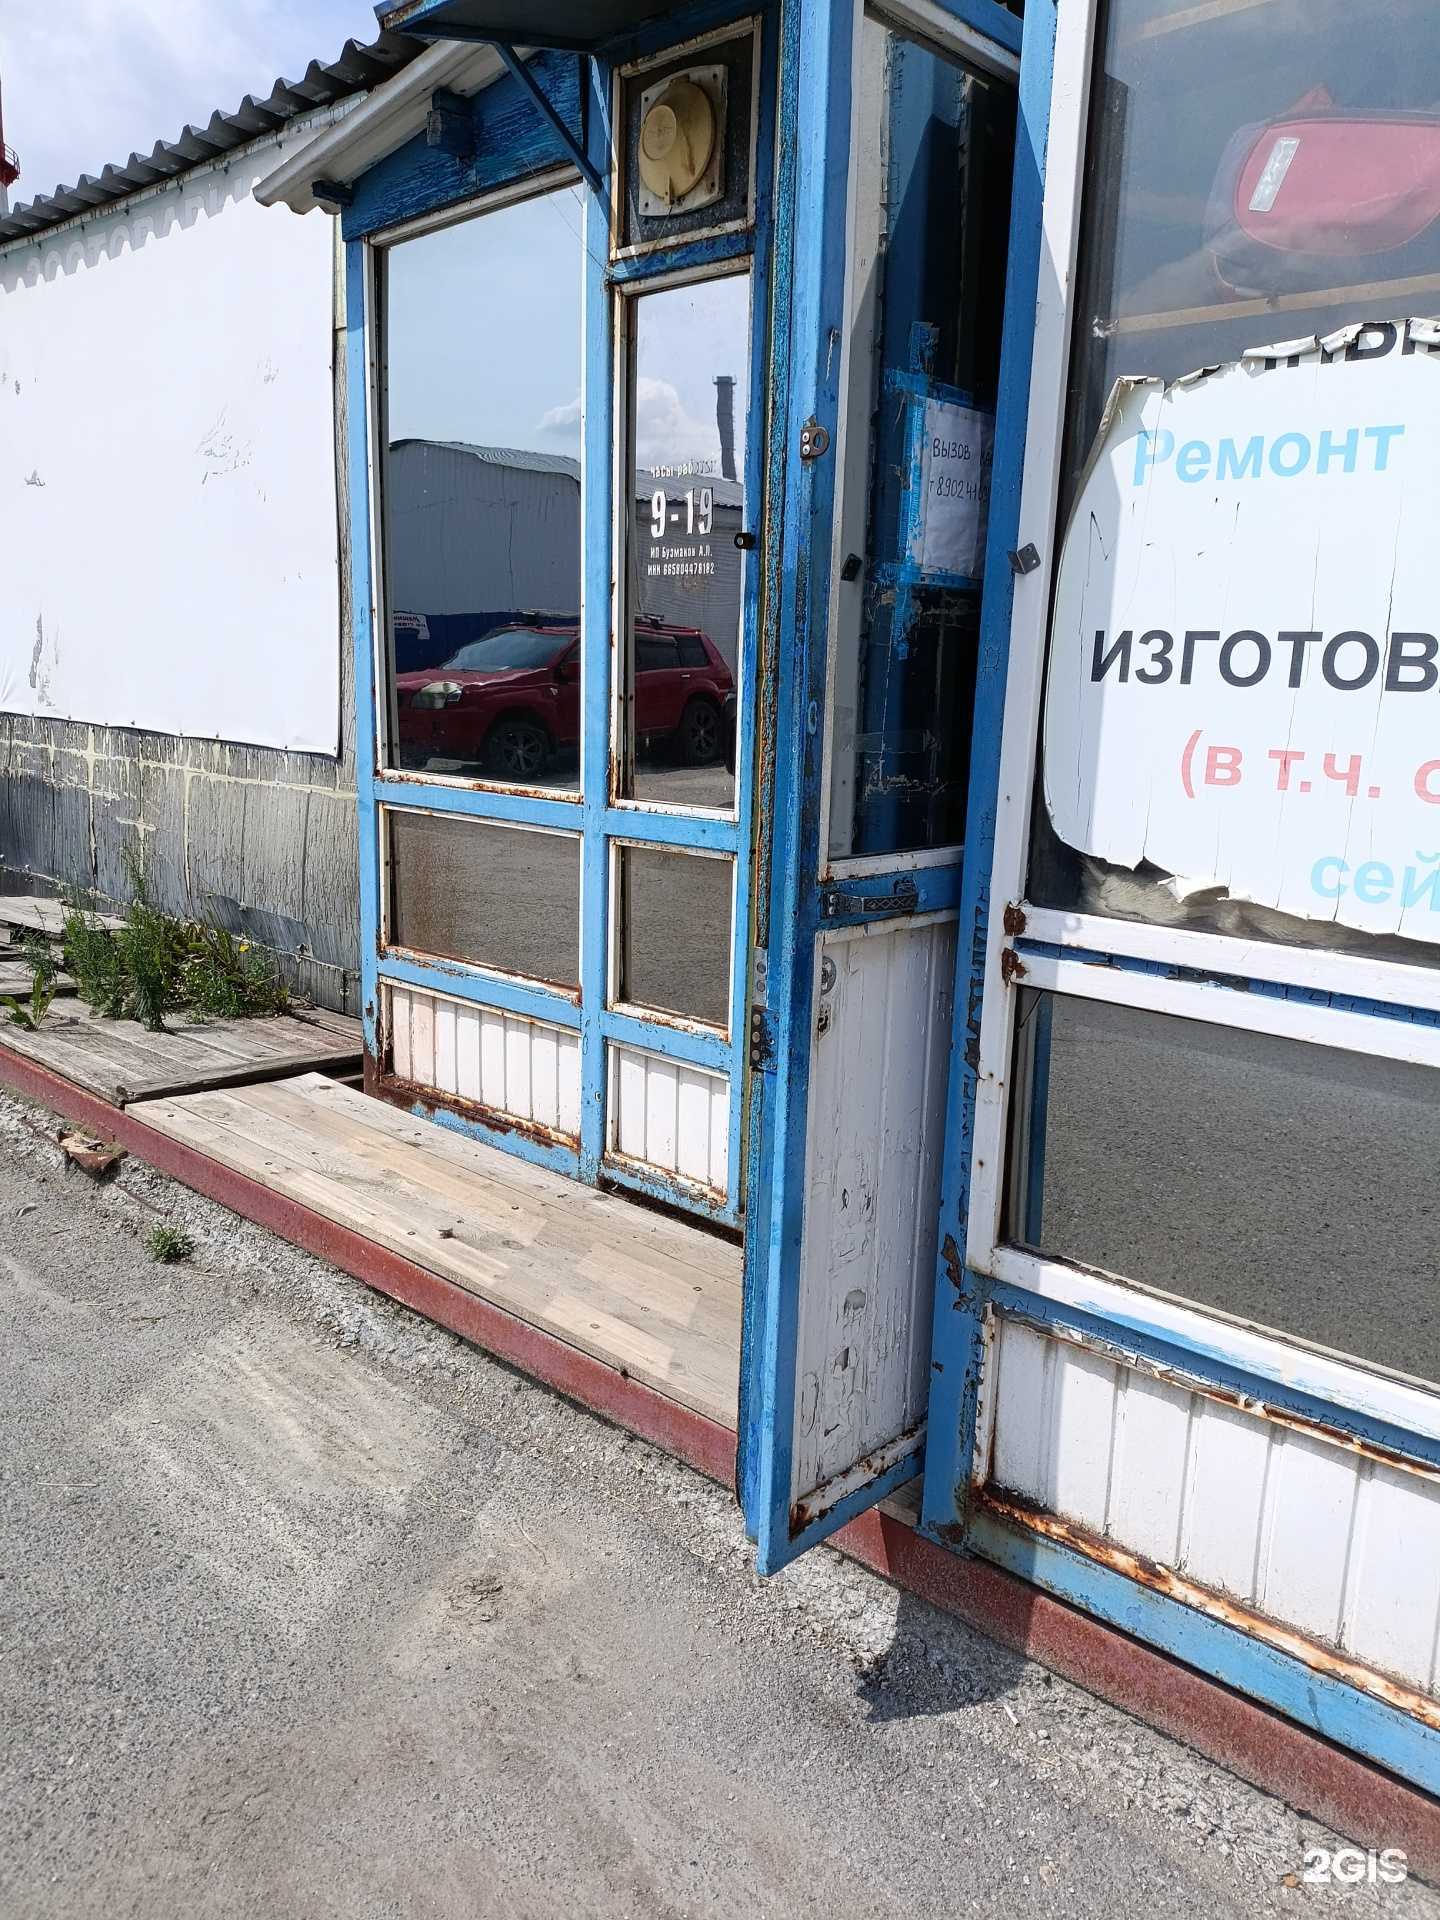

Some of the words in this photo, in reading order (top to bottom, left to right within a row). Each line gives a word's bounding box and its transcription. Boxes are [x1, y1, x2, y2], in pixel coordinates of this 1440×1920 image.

[1132, 425, 1405, 486] Ремонт
[647, 563, 661, 576] ИНН
[650, 546, 660, 559] ИП
[1091, 630, 1440, 692] ИЗГОТОВ
